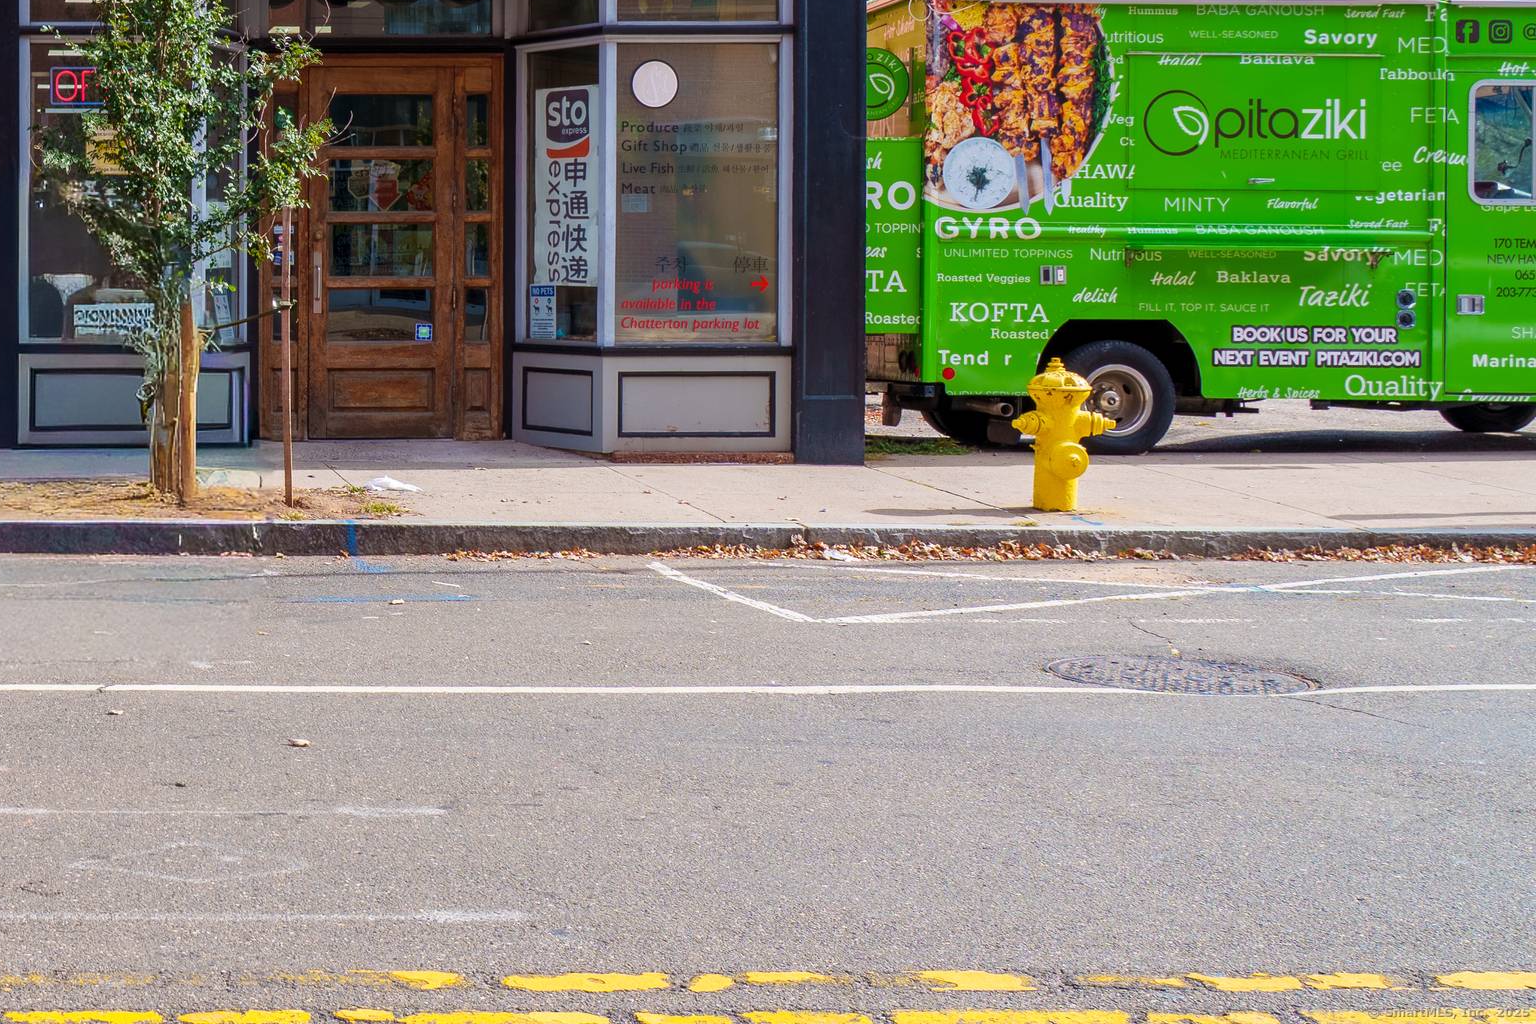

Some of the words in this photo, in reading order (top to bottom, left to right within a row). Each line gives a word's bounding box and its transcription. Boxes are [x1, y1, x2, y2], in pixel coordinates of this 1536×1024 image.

[1128, 6, 1179, 16] Hummus
[1196, 5, 1240, 16] BABA
[1245, 5, 1325, 16] GANOUSH
[1344, 4, 1379, 19] Served
[1382, 8, 1406, 19] Fast
[1104, 31, 1164, 44] utritious
[1189, 30, 1278, 39] WELL-SEASONED
[1304, 29, 1377, 48] Savory
[1240, 54, 1315, 65] Baklava
[1498, 61, 1530, 77] Hot
[547, 95, 588, 127] sto
[1410, 107, 1460, 124] FETA
[621, 121, 679, 133] Produce
[1214, 98, 1367, 148] pitaziki
[561, 127, 588, 136] express
[621, 139, 648, 152] Gift
[653, 139, 688, 155] Shop
[1220, 149, 1330, 160] MEDITERRANEAN
[1336, 149, 1369, 160] GRILL
[622, 162, 647, 174] Live
[650, 162, 674, 174] Fish
[621, 183, 656, 194] Meat
[1053, 192, 1129, 212] Quality
[1164, 197, 1230, 212] MINTY
[1267, 198, 1319, 211] Flavorful
[546, 160, 561, 283] express
[561, 158, 590, 284] 申通快递
[875, 222, 924, 233] TOPPIN
[934, 216, 1042, 240] GYRO
[1494, 238, 1512, 249] 170
[944, 248, 1009, 258] UNLIMITED
[1015, 249, 1073, 259] TOPPINGS
[1090, 248, 1162, 261] Nutrious
[1188, 249, 1277, 259] WELL-SEASONED
[1487, 254, 1514, 264] NEW
[652, 277, 701, 294] parking
[705, 279, 714, 291] is
[936, 272, 982, 282] Roasted
[986, 273, 1031, 284] Veggies
[1151, 271, 1196, 286] Halal
[1216, 270, 1291, 284] Baklava
[532, 287, 540, 295] NO
[540, 287, 554, 295] PETS
[1072, 287, 1118, 304] delish
[1298, 282, 1373, 307] Taziki
[621, 297, 675, 310] available
[680, 298, 691, 310] in
[696, 297, 717, 310] the
[1138, 303, 1161, 312] FILL
[1181, 303, 1202, 312] TOP
[1220, 303, 1257, 312] SAUCE
[1260, 303, 1269, 312] IT
[949, 302, 1049, 322] KOFTA
[621, 317, 689, 330] Chatterton
[693, 318, 740, 333] parking
[744, 318, 761, 330] lot
[991, 328, 1049, 339] Roasted
[1232, 327, 1282, 342] BOOK
[1283, 327, 1309, 342] US
[1313, 327, 1347, 342] FOR
[1352, 327, 1397, 343] YOUR
[1213, 350, 1254, 365] NEXT
[1259, 350, 1309, 365] EVENT
[1317, 350, 1420, 366] PITAZIKI.COM
[1237, 385, 1268, 398] Herbs
[1285, 386, 1320, 398] Spices
[1344, 374, 1444, 401] Quality
